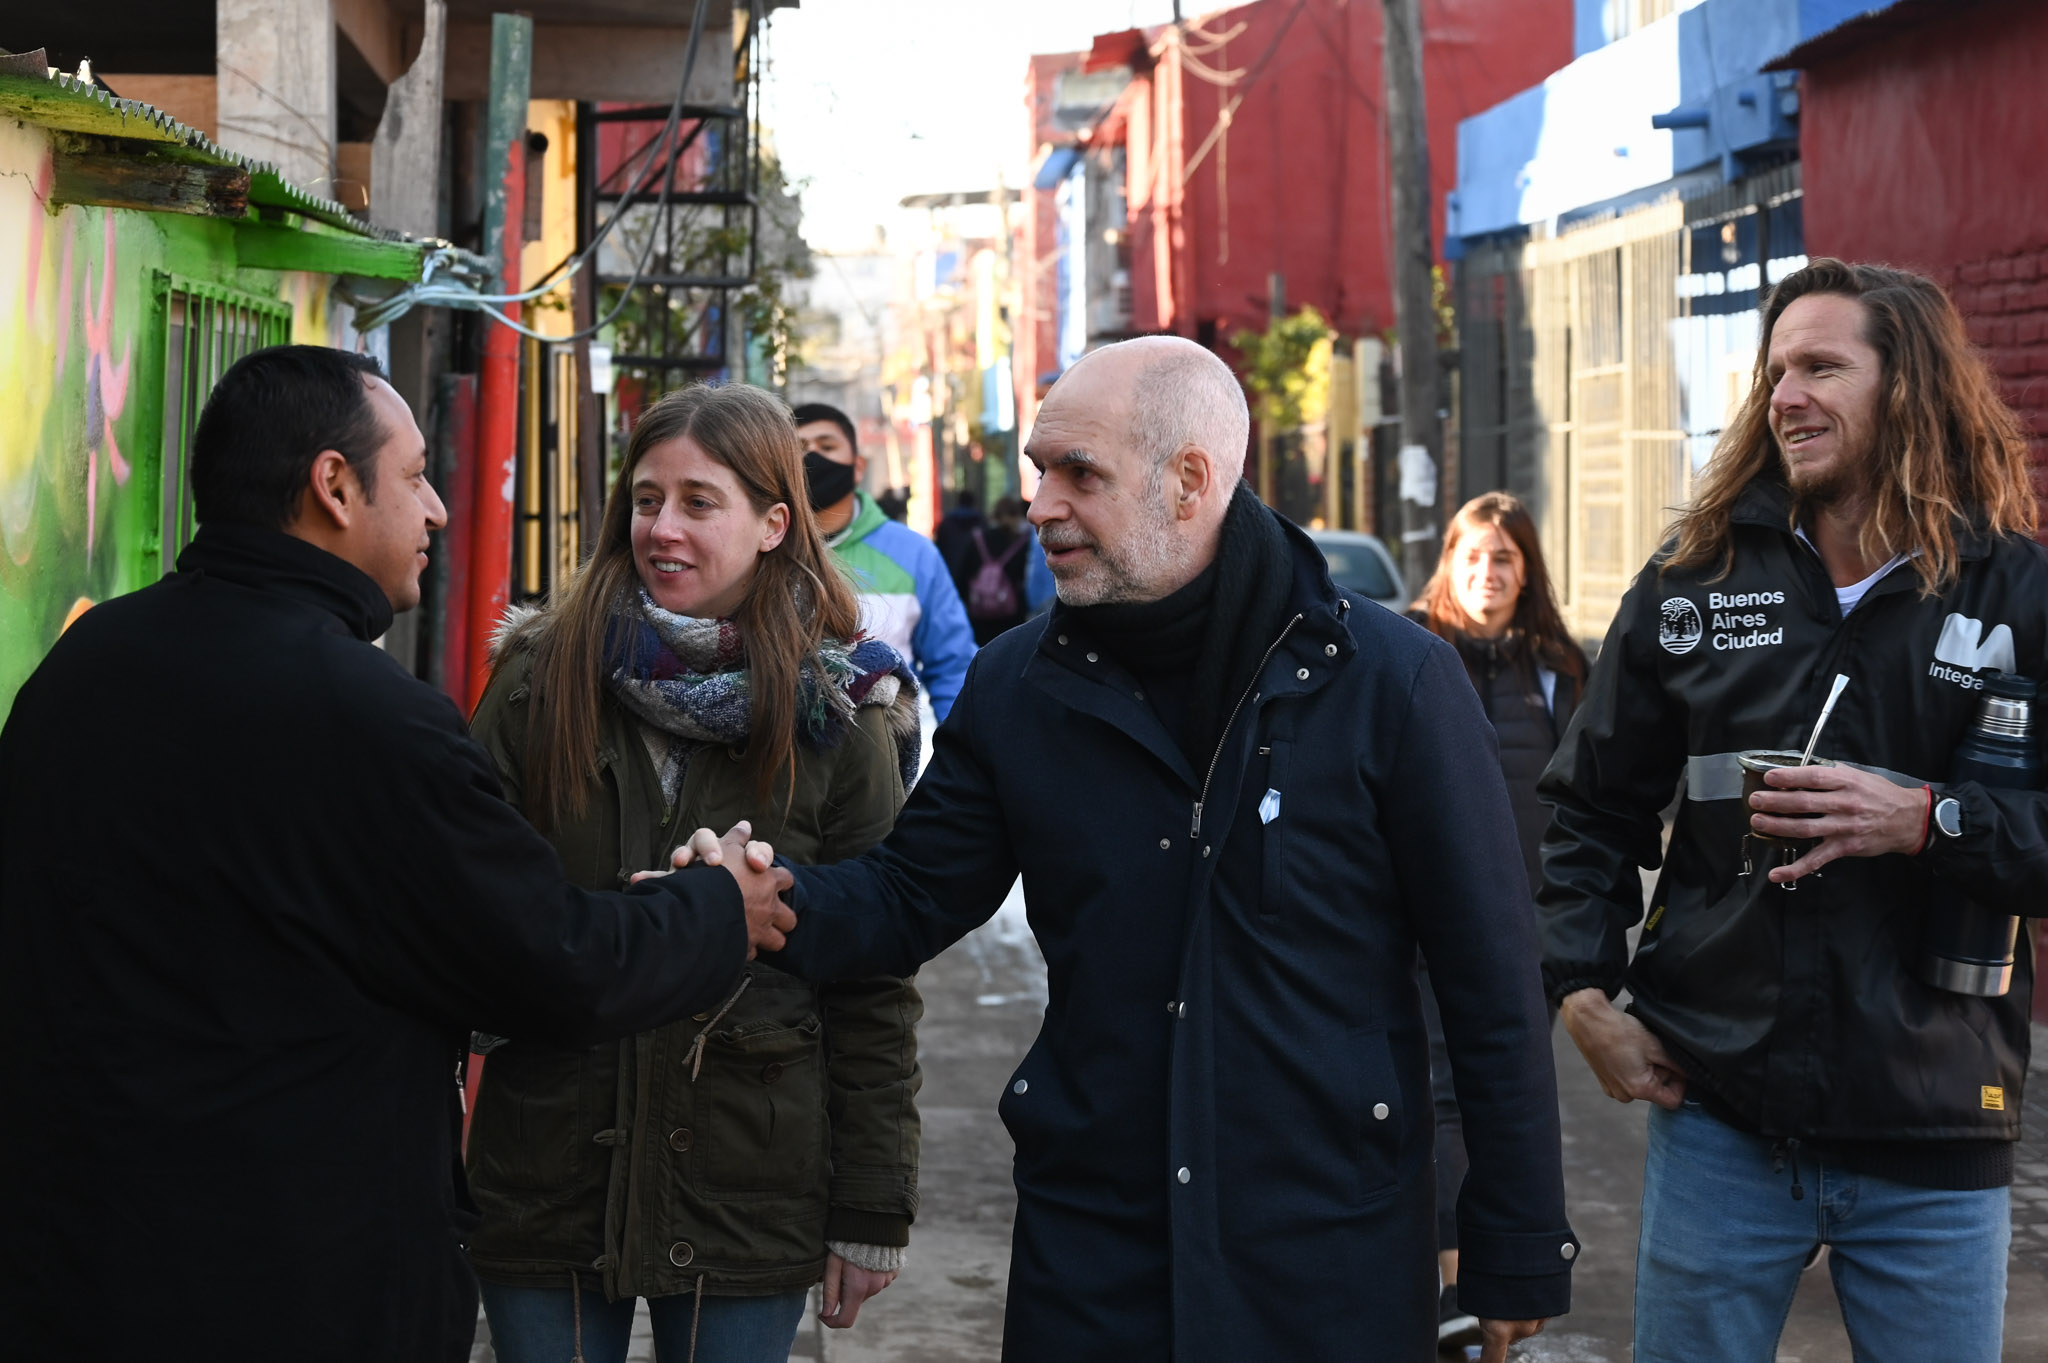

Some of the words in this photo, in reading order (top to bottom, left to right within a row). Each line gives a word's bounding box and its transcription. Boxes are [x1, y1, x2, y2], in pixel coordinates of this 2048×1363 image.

[1709, 591, 1785, 609] Buenos
[1712, 612, 1767, 630] Aires
[1712, 627, 1783, 650] Ciudad
